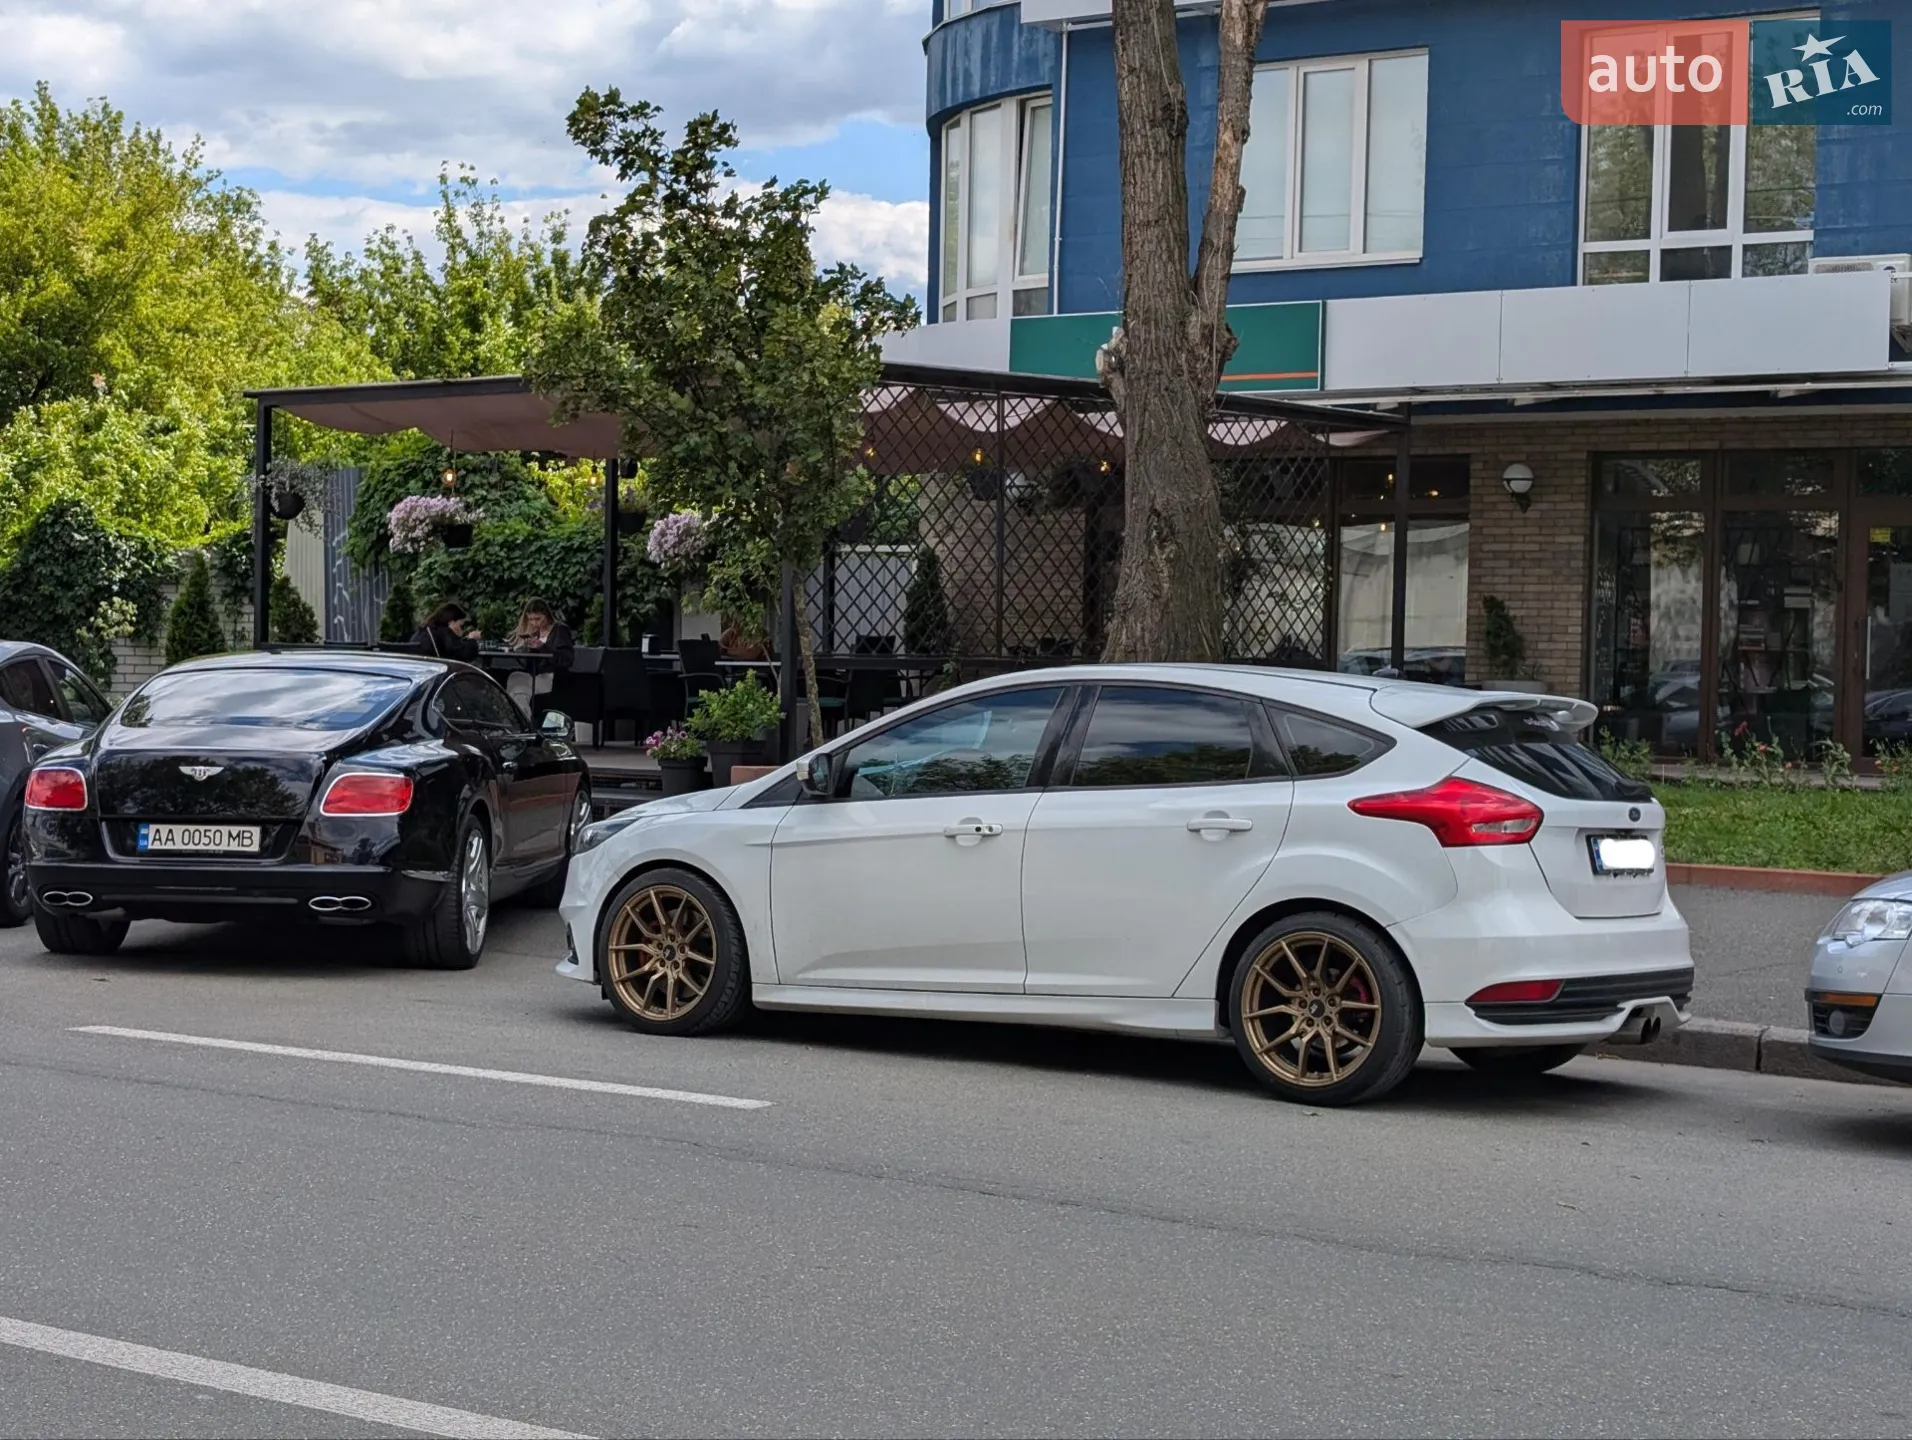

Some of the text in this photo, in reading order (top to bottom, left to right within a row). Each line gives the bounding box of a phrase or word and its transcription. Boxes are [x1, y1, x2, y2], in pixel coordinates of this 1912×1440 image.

[151, 828, 254, 848] AA 0050 MB
